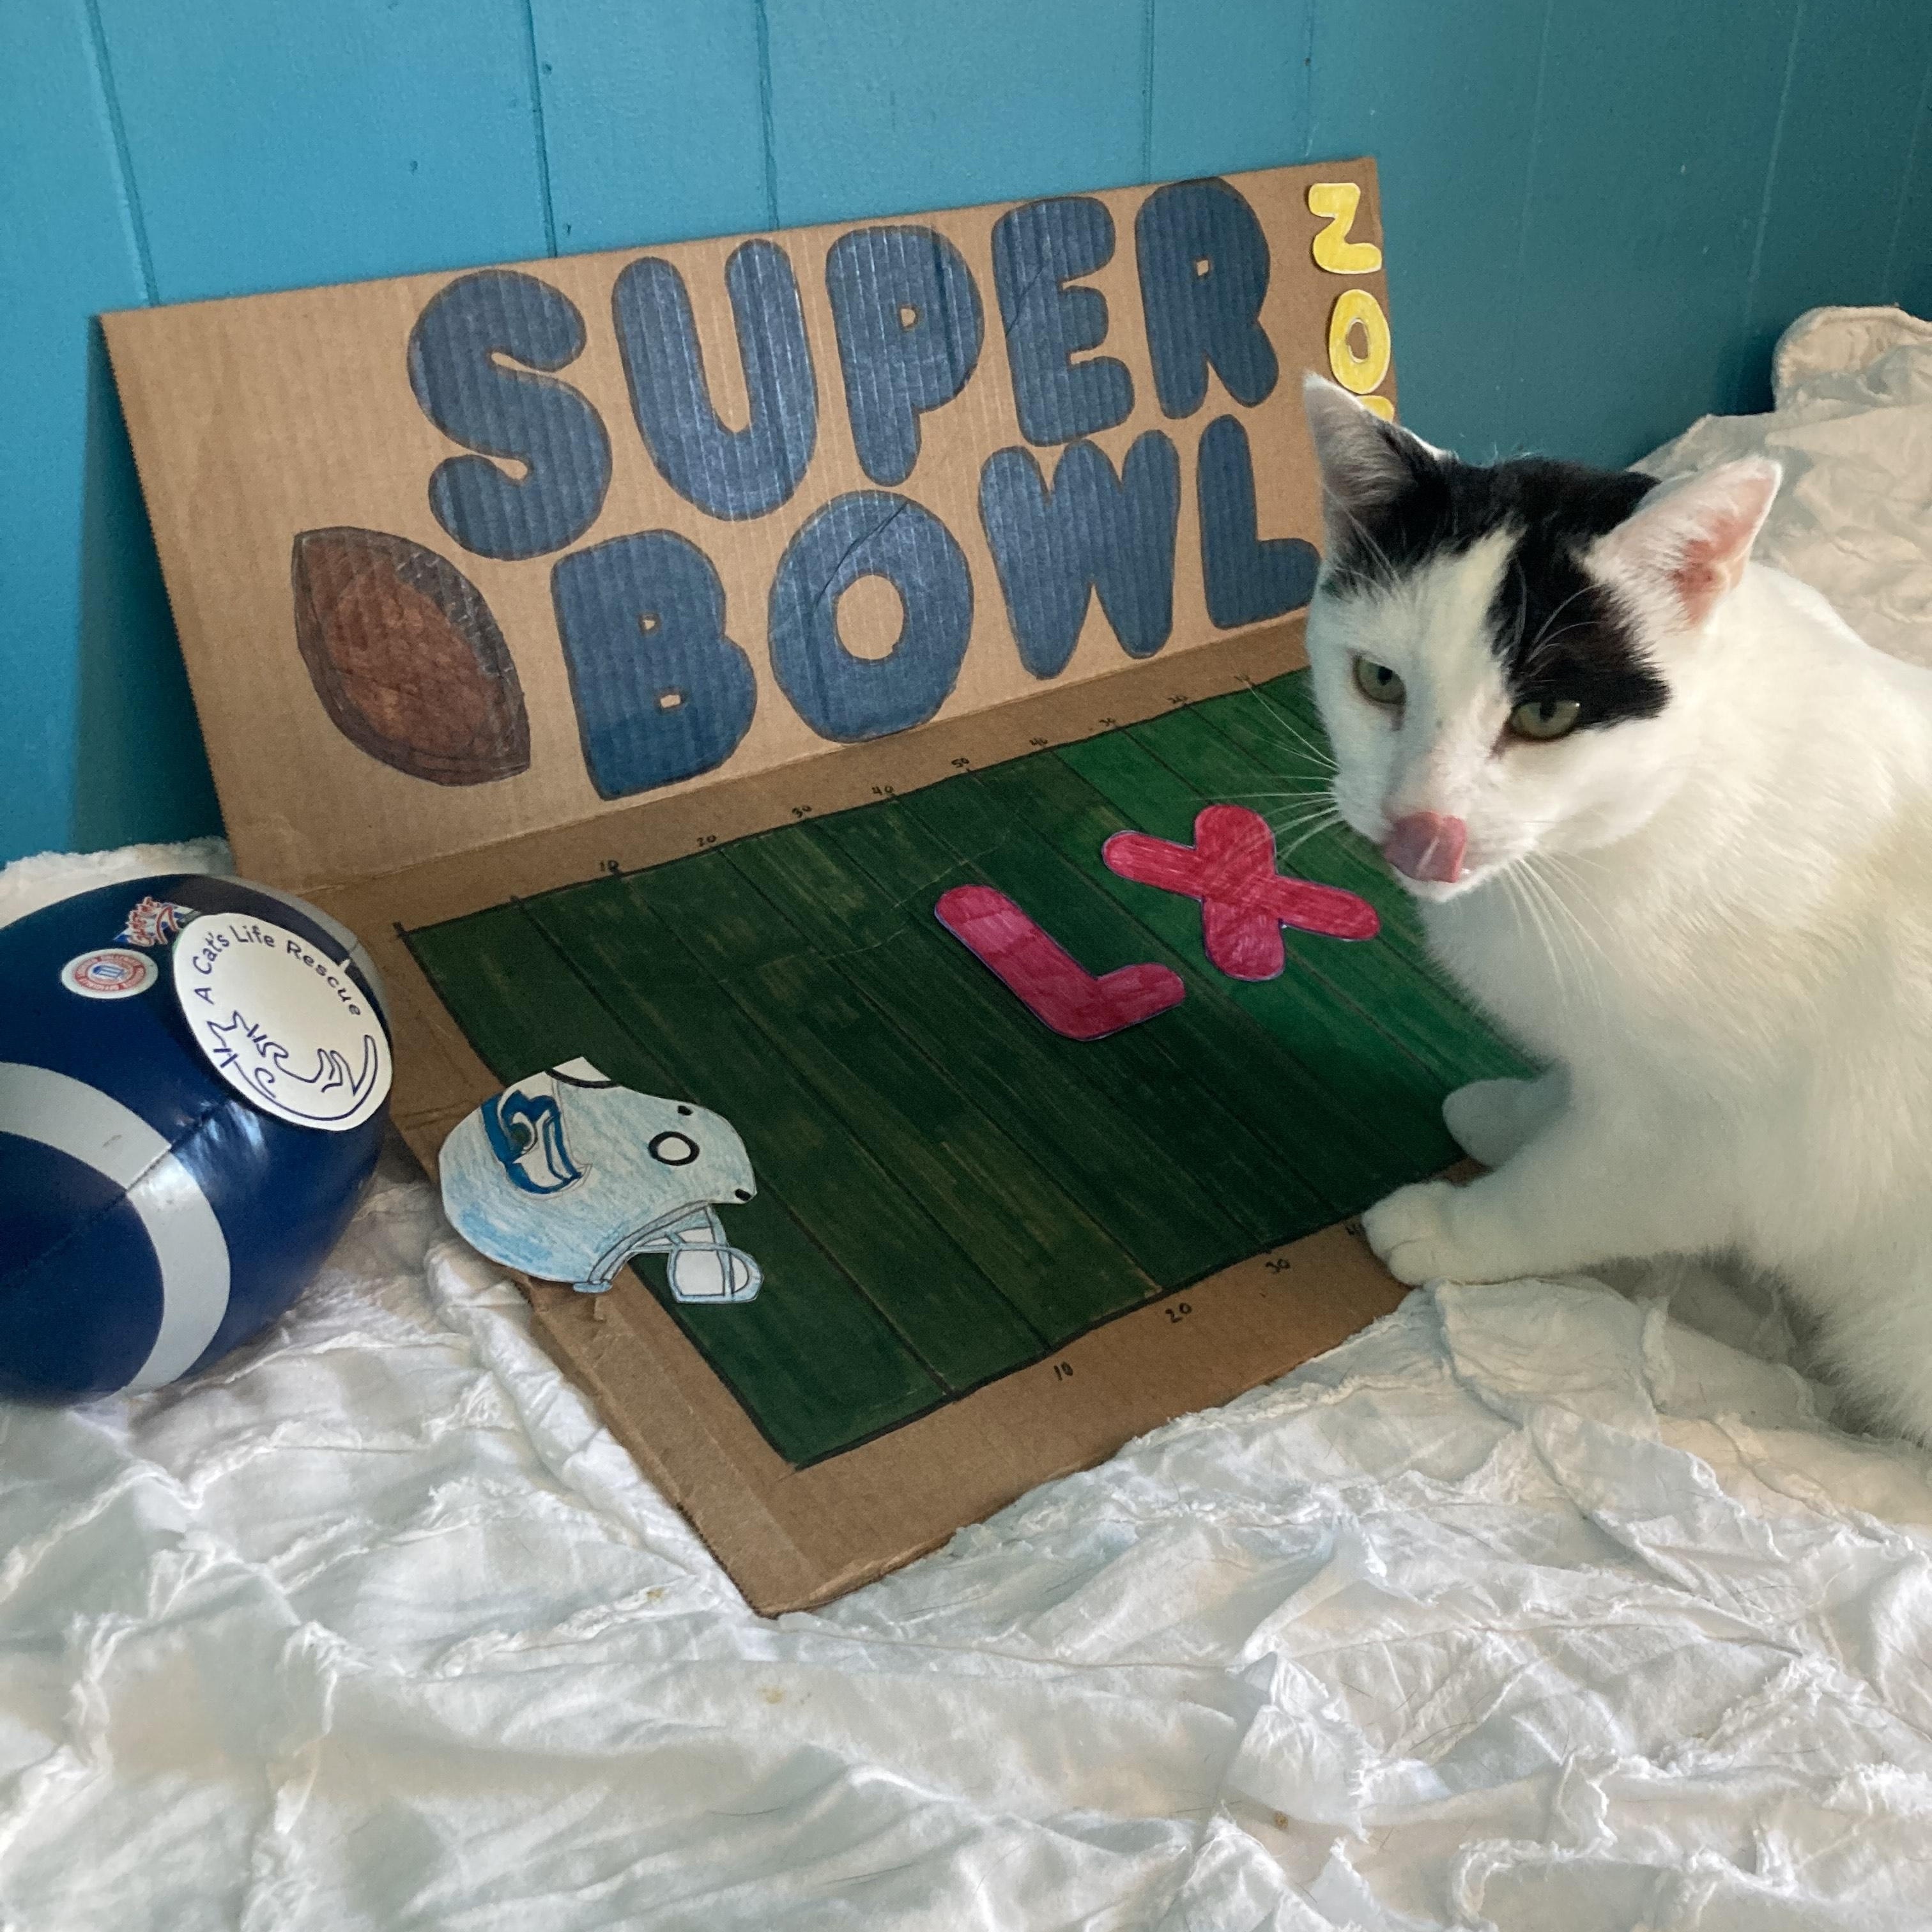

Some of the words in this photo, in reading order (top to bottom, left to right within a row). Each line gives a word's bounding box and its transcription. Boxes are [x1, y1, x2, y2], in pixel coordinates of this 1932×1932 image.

[407, 176, 1278, 560] SUPER
[550, 414, 1320, 801] BOWL
[696, 834, 717, 848] 20
[792, 804, 812, 818] 30
[871, 785, 894, 796] 40
[951, 757, 970, 769] 50
[193, 931, 230, 975] Cat's
[229, 924, 275, 948] Life
[194, 987, 215, 1005] A
[287, 940, 361, 1016] Rescue
[1054, 1361, 1074, 1381] 10
[1165, 1301, 1193, 1324] 20
[1264, 1258, 1291, 1275] 30
